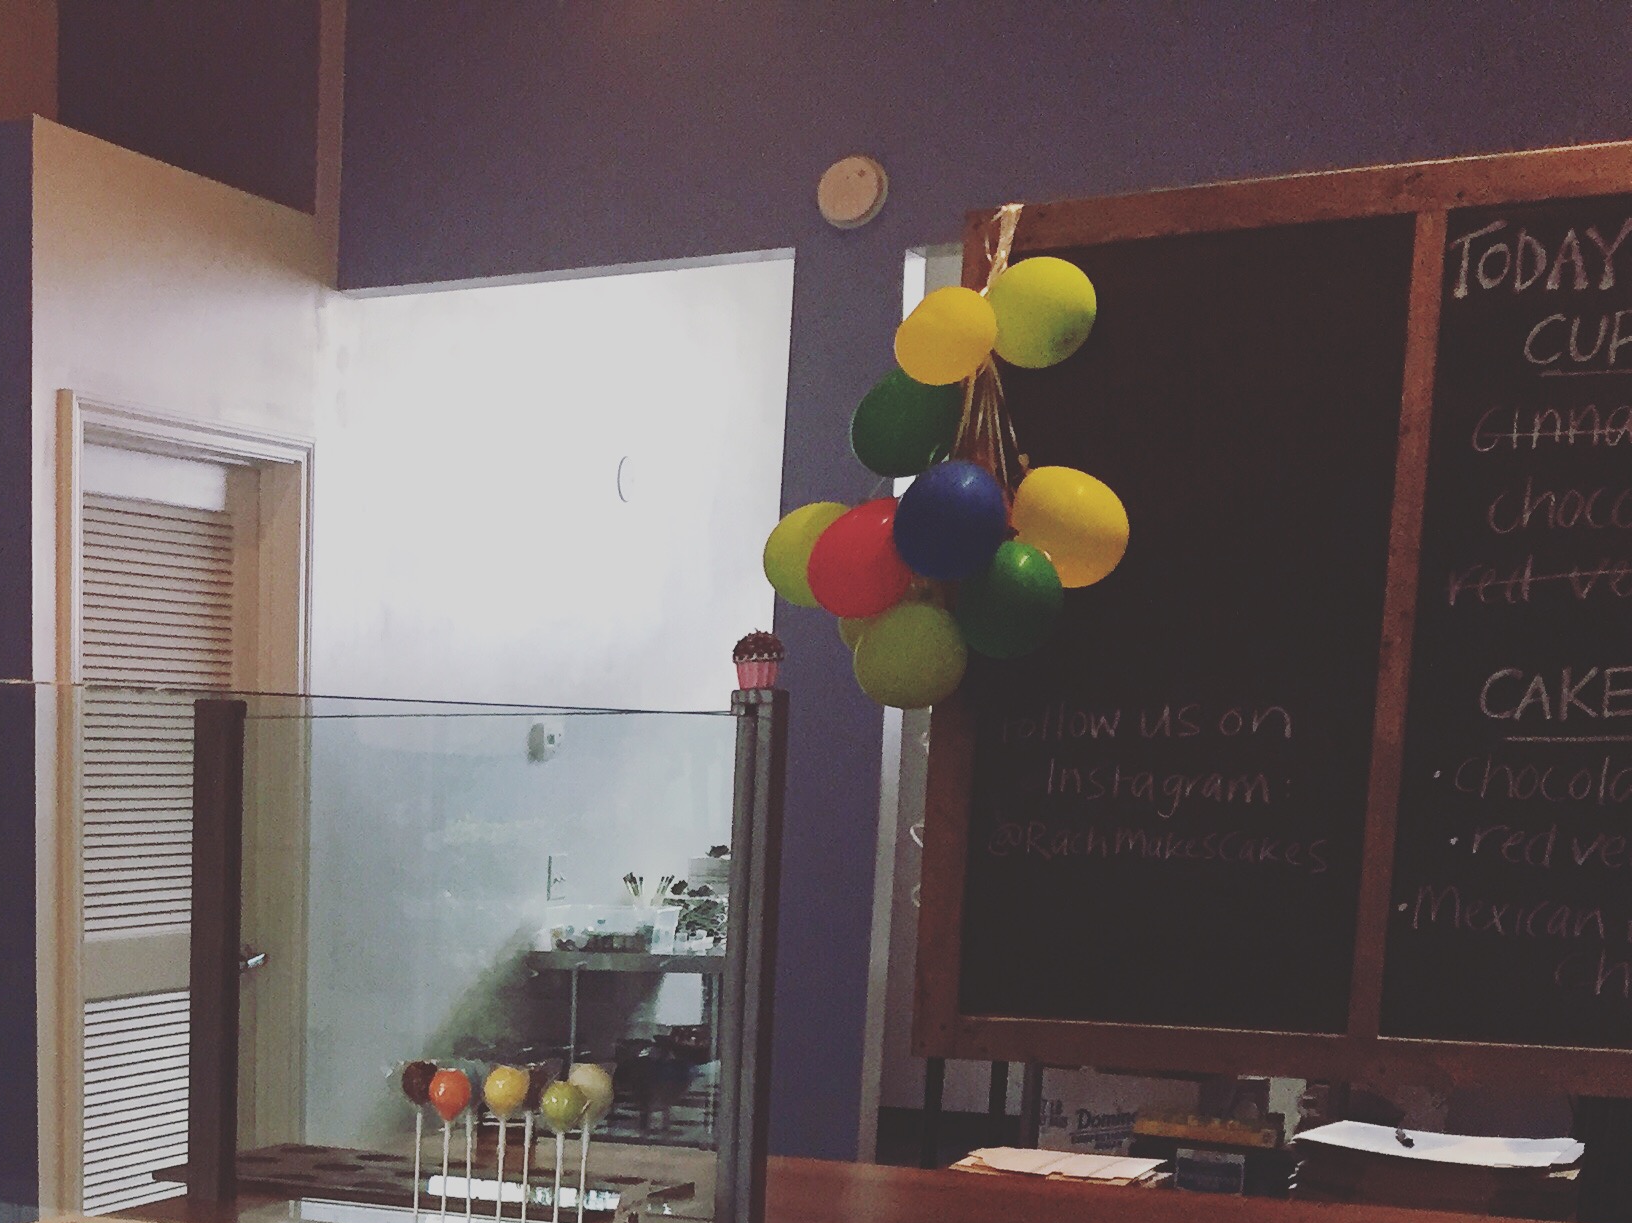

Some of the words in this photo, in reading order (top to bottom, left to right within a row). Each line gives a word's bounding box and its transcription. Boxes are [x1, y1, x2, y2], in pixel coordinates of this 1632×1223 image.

[1478, 665, 1632, 722] CAKE
[1139, 702, 1201, 740] us
[1218, 704, 1293, 740] on
[1470, 823, 1560, 869] red
[1412, 883, 1605, 939] Mexican
